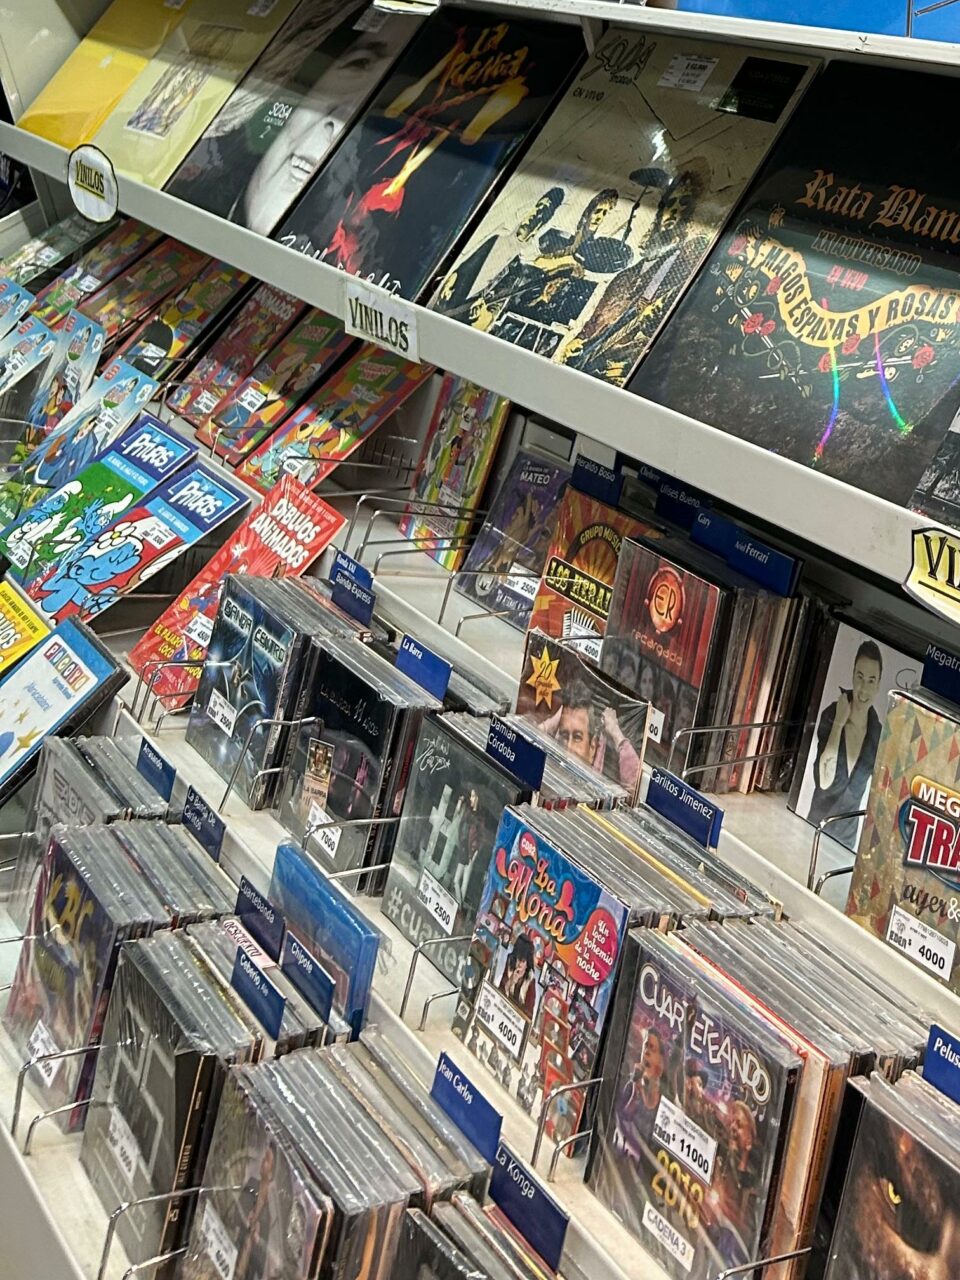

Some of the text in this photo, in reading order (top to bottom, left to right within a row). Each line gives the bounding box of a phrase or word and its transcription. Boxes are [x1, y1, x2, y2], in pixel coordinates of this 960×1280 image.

[573, 86, 605, 102] EN VIVO
[268, 101, 293, 120] SOSA
[75, 159, 105, 194] VINILOS
[794, 169, 875, 220] Rata
[831, 234, 922, 276] ANIVERSARIO
[764, 246, 955, 343] MAGOS ESPADAS Y ROSAS
[348, 295, 409, 353] VINILOS
[520, 471, 550, 485] MATEO
[660, 483, 701, 508] Ulises Bueno
[697, 512, 712, 528] Gary
[580, 527, 603, 545] GRUPO
[337, 553, 349, 568] Banda
[745, 543, 770, 565] Ferrari
[336, 572, 371, 605] Banda Express
[550, 561, 570, 590] LOS
[521, 582, 536, 596] 2500
[224, 599, 253, 632] BANDA
[158, 642, 175, 659] LOCO
[409, 641, 423, 660] Barra
[584, 644, 599, 659] 4000
[43, 642, 90, 693] POCOYO
[537, 660, 552, 681] 20
[490, 718, 516, 743] Damián
[488, 732, 516, 763] Córdoba
[650, 768, 714, 819] Carlitos Jimenez
[321, 830, 335, 852] 7000
[535, 859, 557, 896] La
[241, 876, 275, 924] Cuartebanda
[505, 858, 566, 943] Mona
[434, 902, 451, 927] 2500
[592, 927, 606, 945] loco
[597, 919, 610, 937] Un
[291, 942, 313, 974] Chipote
[574, 940, 590, 960] de la
[583, 933, 614, 966] bohemio
[918, 944, 945, 970] 4000
[576, 956, 601, 981] noche
[499, 1020, 517, 1046] 4000
[438, 1058, 473, 1105] Jean Carlos
[680, 1137, 709, 1175] 11000
[495, 1144, 536, 1200] La Konga
[647, 1207, 680, 1250] CADENA
